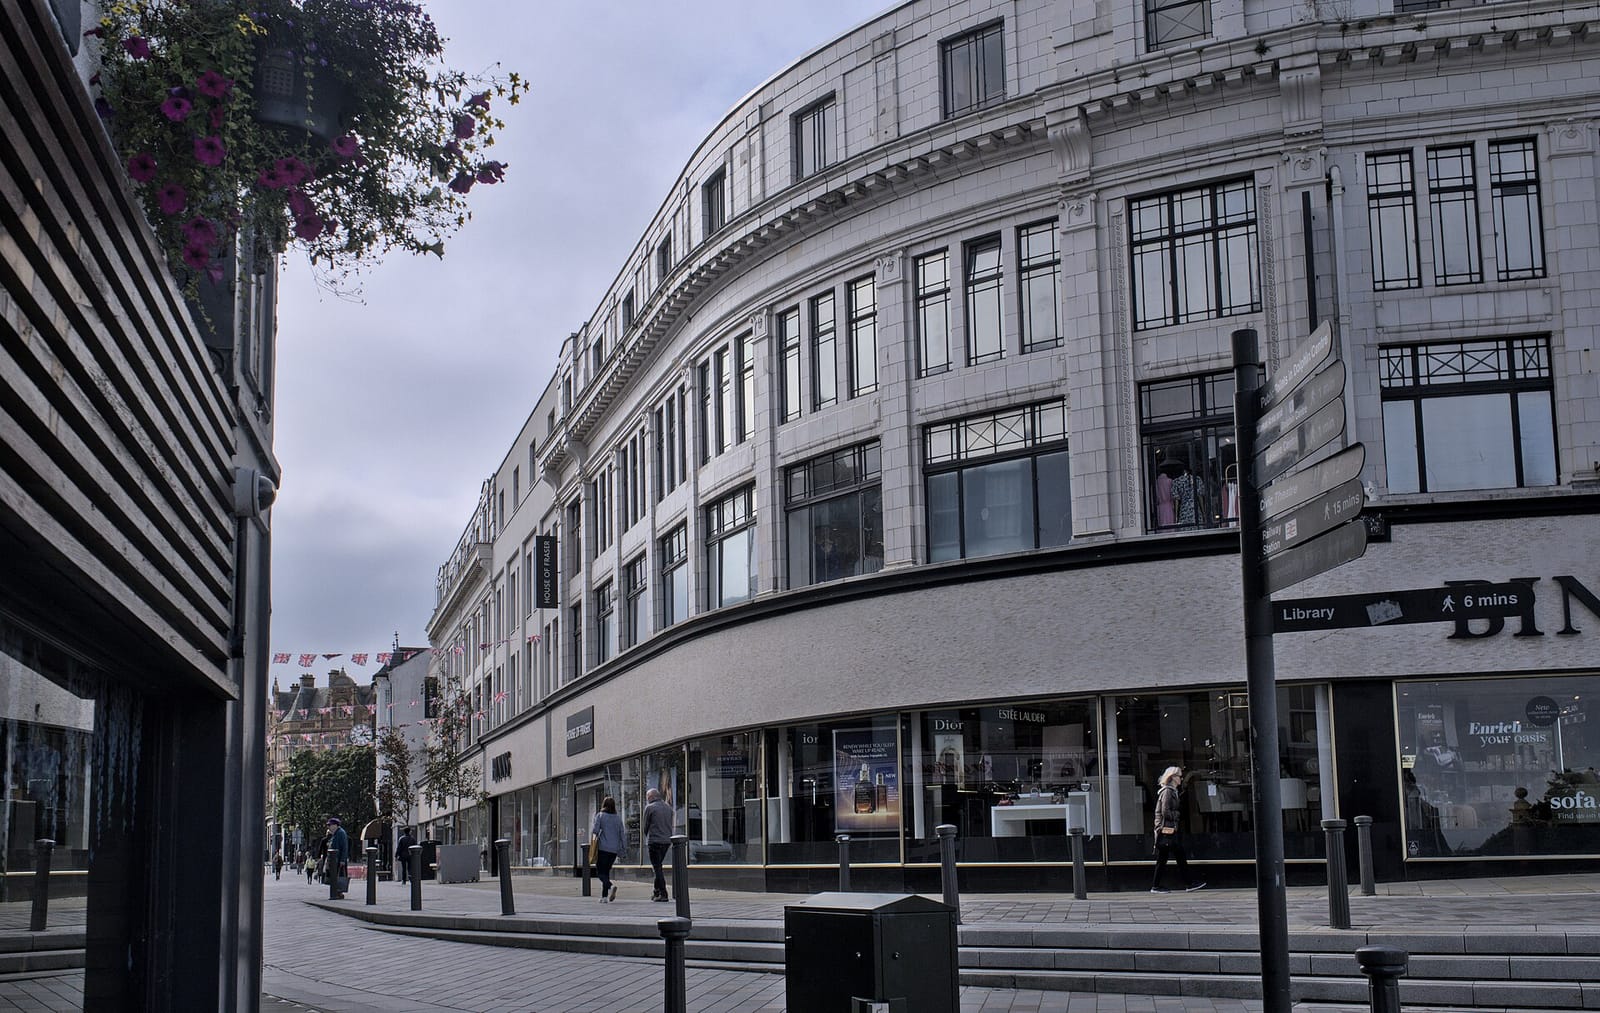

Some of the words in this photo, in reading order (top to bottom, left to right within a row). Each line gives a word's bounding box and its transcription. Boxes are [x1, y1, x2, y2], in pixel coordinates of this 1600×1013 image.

[1333, 501, 1342, 515] 15
[1342, 493, 1360, 511] mins
[1262, 525, 1281, 540] Railway
[543, 540, 551, 566] FRASER
[1262, 541, 1281, 555] Station
[543, 567, 551, 578] OF
[543, 579, 551, 604] HOUSE
[1282, 607, 1335, 621] Library
[1463, 595, 1474, 608] 6
[1478, 592, 1518, 607] mins
[1019, 711, 1046, 722] LAUDER
[935, 719, 964, 731] Dior
[1468, 721, 1521, 735] Enrich
[803, 733, 818, 744] ior
[1480, 735, 1511, 748] your
[1513, 731, 1546, 744] oasis
